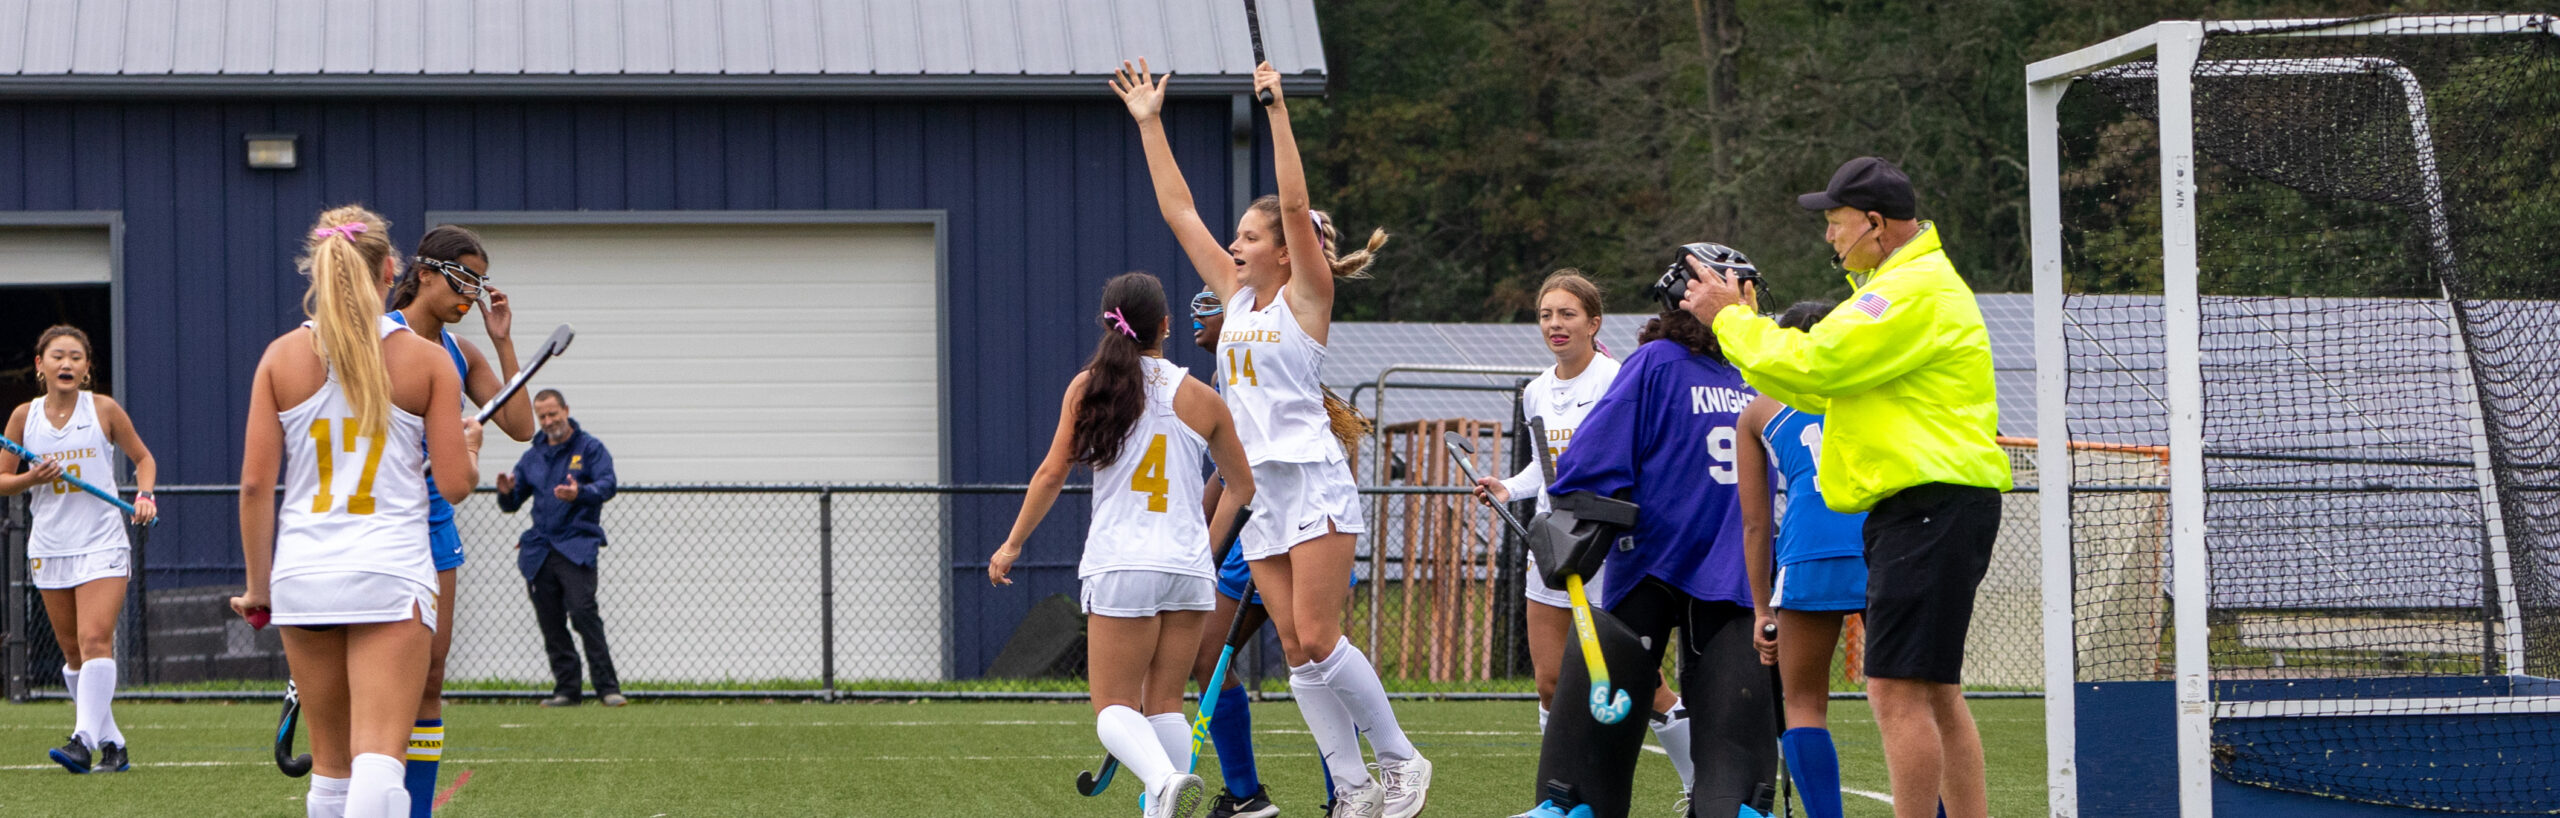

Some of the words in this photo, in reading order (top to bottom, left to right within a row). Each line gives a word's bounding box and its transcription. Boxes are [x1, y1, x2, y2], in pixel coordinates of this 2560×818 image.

[1220, 330, 1281, 343] EDDIE
[1227, 348, 1258, 387] 14
[309, 417, 388, 515] 17
[1131, 433, 1169, 513] 4
[1706, 426, 1739, 485] 9
[1593, 686, 1630, 714] GK
[1192, 711, 1212, 757] STX
